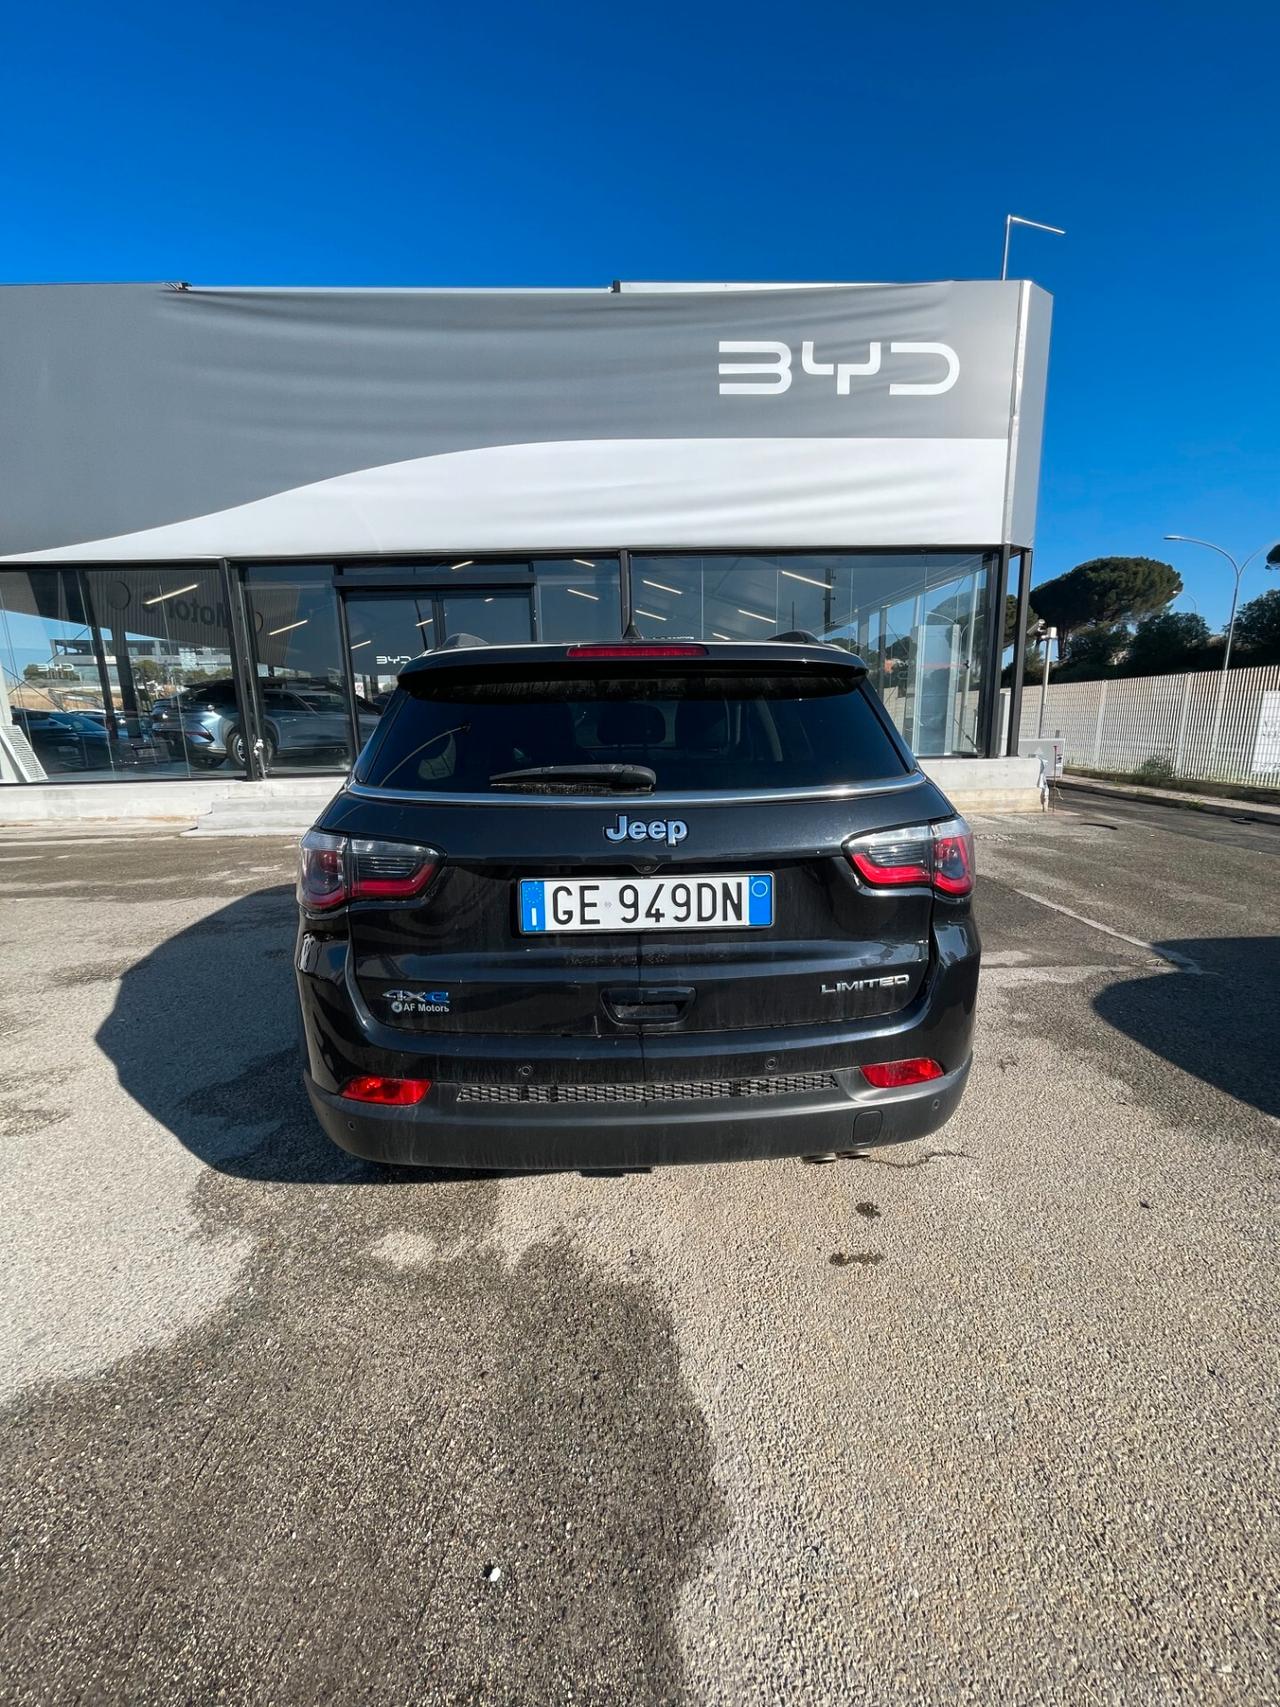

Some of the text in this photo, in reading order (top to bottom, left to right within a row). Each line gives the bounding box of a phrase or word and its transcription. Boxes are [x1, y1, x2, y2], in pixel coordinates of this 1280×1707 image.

[719, 341, 960, 395] BYD
[37, 663, 74, 672] BYD
[376, 655, 412, 665] BYD
[603, 814, 688, 847] Jeep
[552, 882, 743, 925] GE 949DN
[820, 974, 910, 993] LIMITED
[403, 1003, 450, 1013] AF Motors
